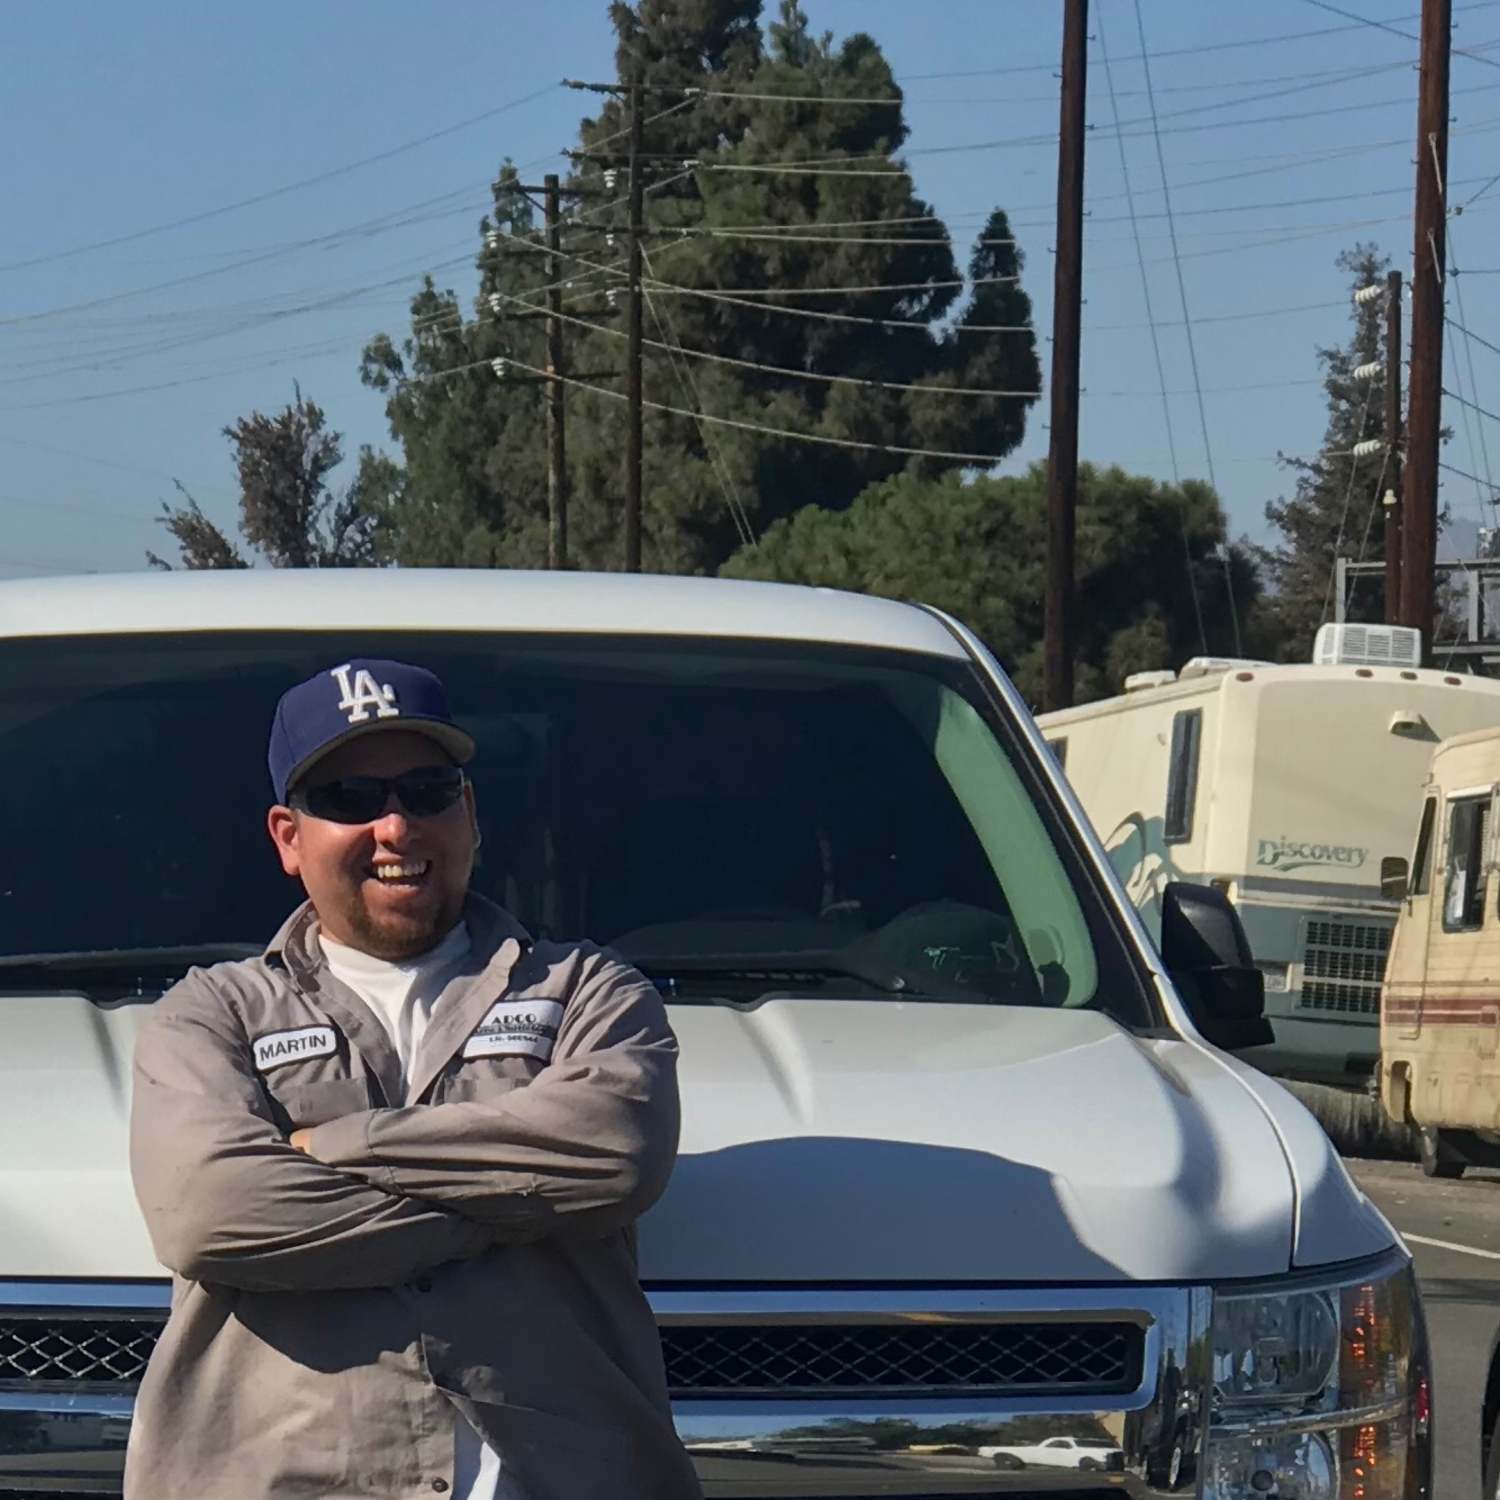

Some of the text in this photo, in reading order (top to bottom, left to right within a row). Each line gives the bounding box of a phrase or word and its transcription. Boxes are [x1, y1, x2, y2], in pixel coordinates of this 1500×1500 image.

[331, 663, 399, 723] LA
[1256, 835, 1369, 870] Discovery
[491, 1013, 537, 1024] ADCO
[259, 1034, 327, 1061] MARTIN
